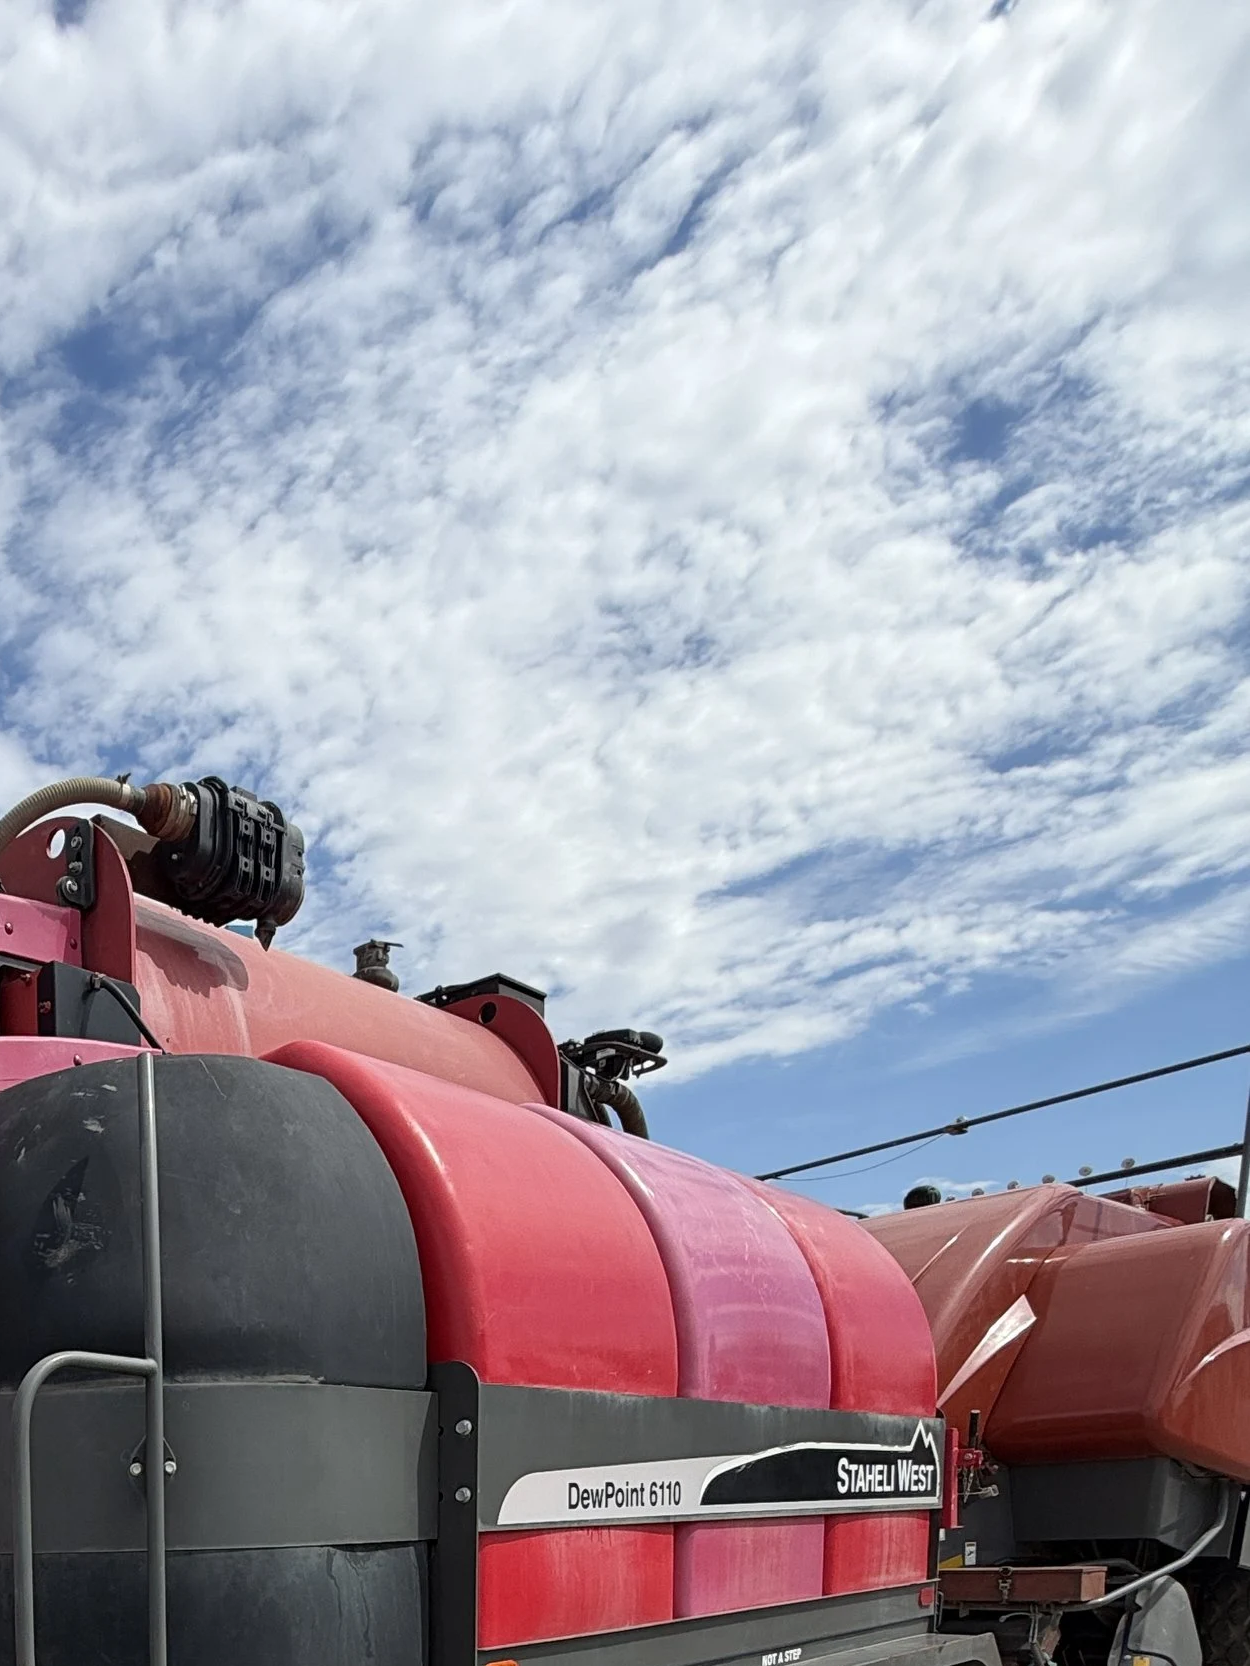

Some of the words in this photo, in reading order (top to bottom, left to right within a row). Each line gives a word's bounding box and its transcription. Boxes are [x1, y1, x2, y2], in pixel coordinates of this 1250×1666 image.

[837, 1457, 895, 1494] STAHELI
[897, 1459, 934, 1491] WEST
[568, 1481, 645, 1509] DewPoint
[649, 1481, 681, 1506] 6110
[762, 1653, 777, 1666] NOT
[778, 1651, 783, 1664] A
[784, 1648, 802, 1662] STEP
